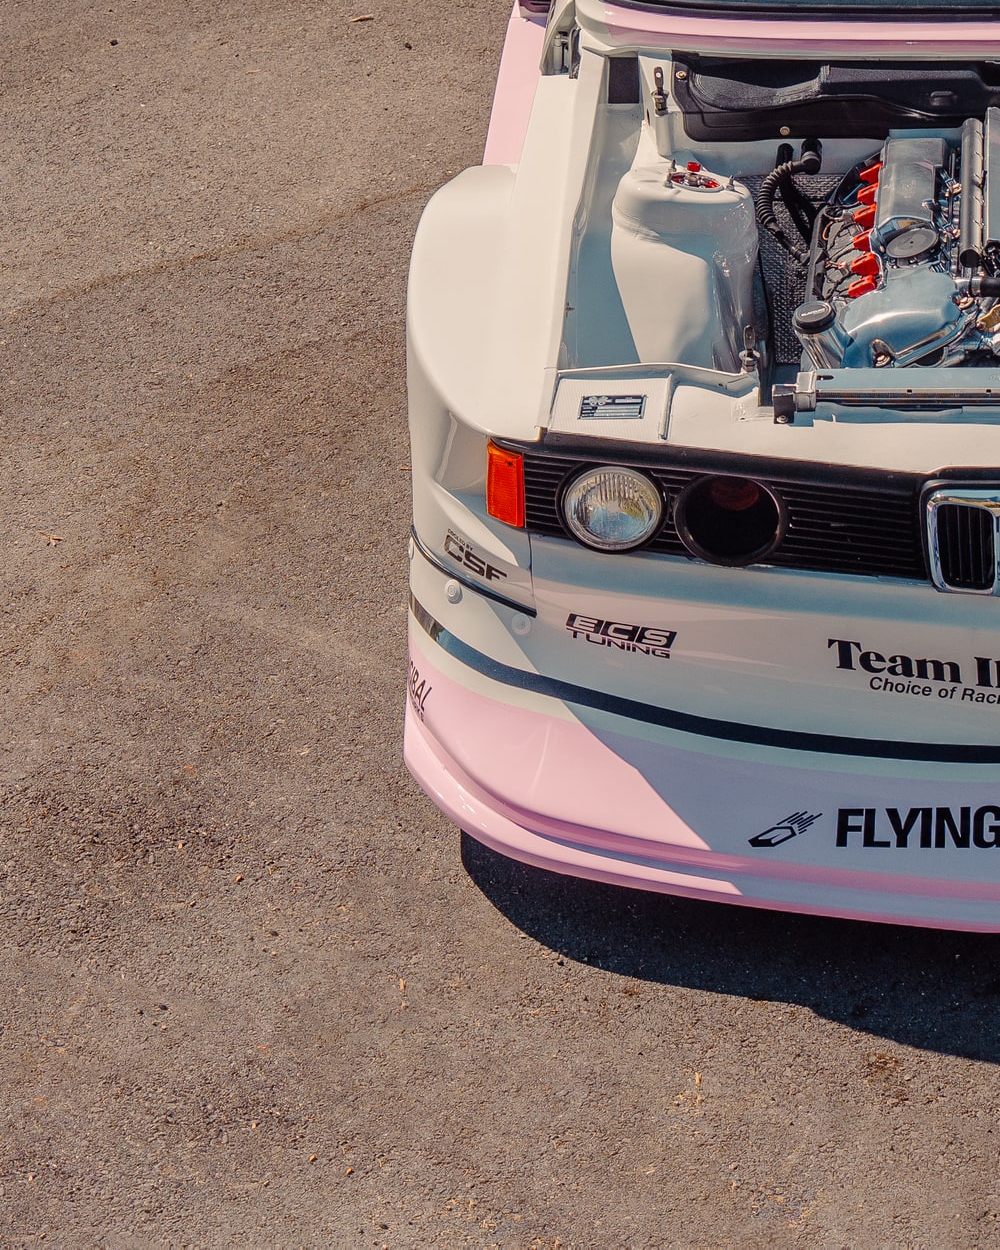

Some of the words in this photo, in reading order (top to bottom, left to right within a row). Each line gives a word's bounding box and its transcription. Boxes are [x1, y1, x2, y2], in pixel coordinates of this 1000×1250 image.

[444, 534, 508, 581] CSF
[566, 627, 671, 660] TUNING
[567, 613, 677, 648] ECS
[827, 638, 963, 684] Team
[869, 676, 933, 697] Choice
[938, 685, 958, 700] of
